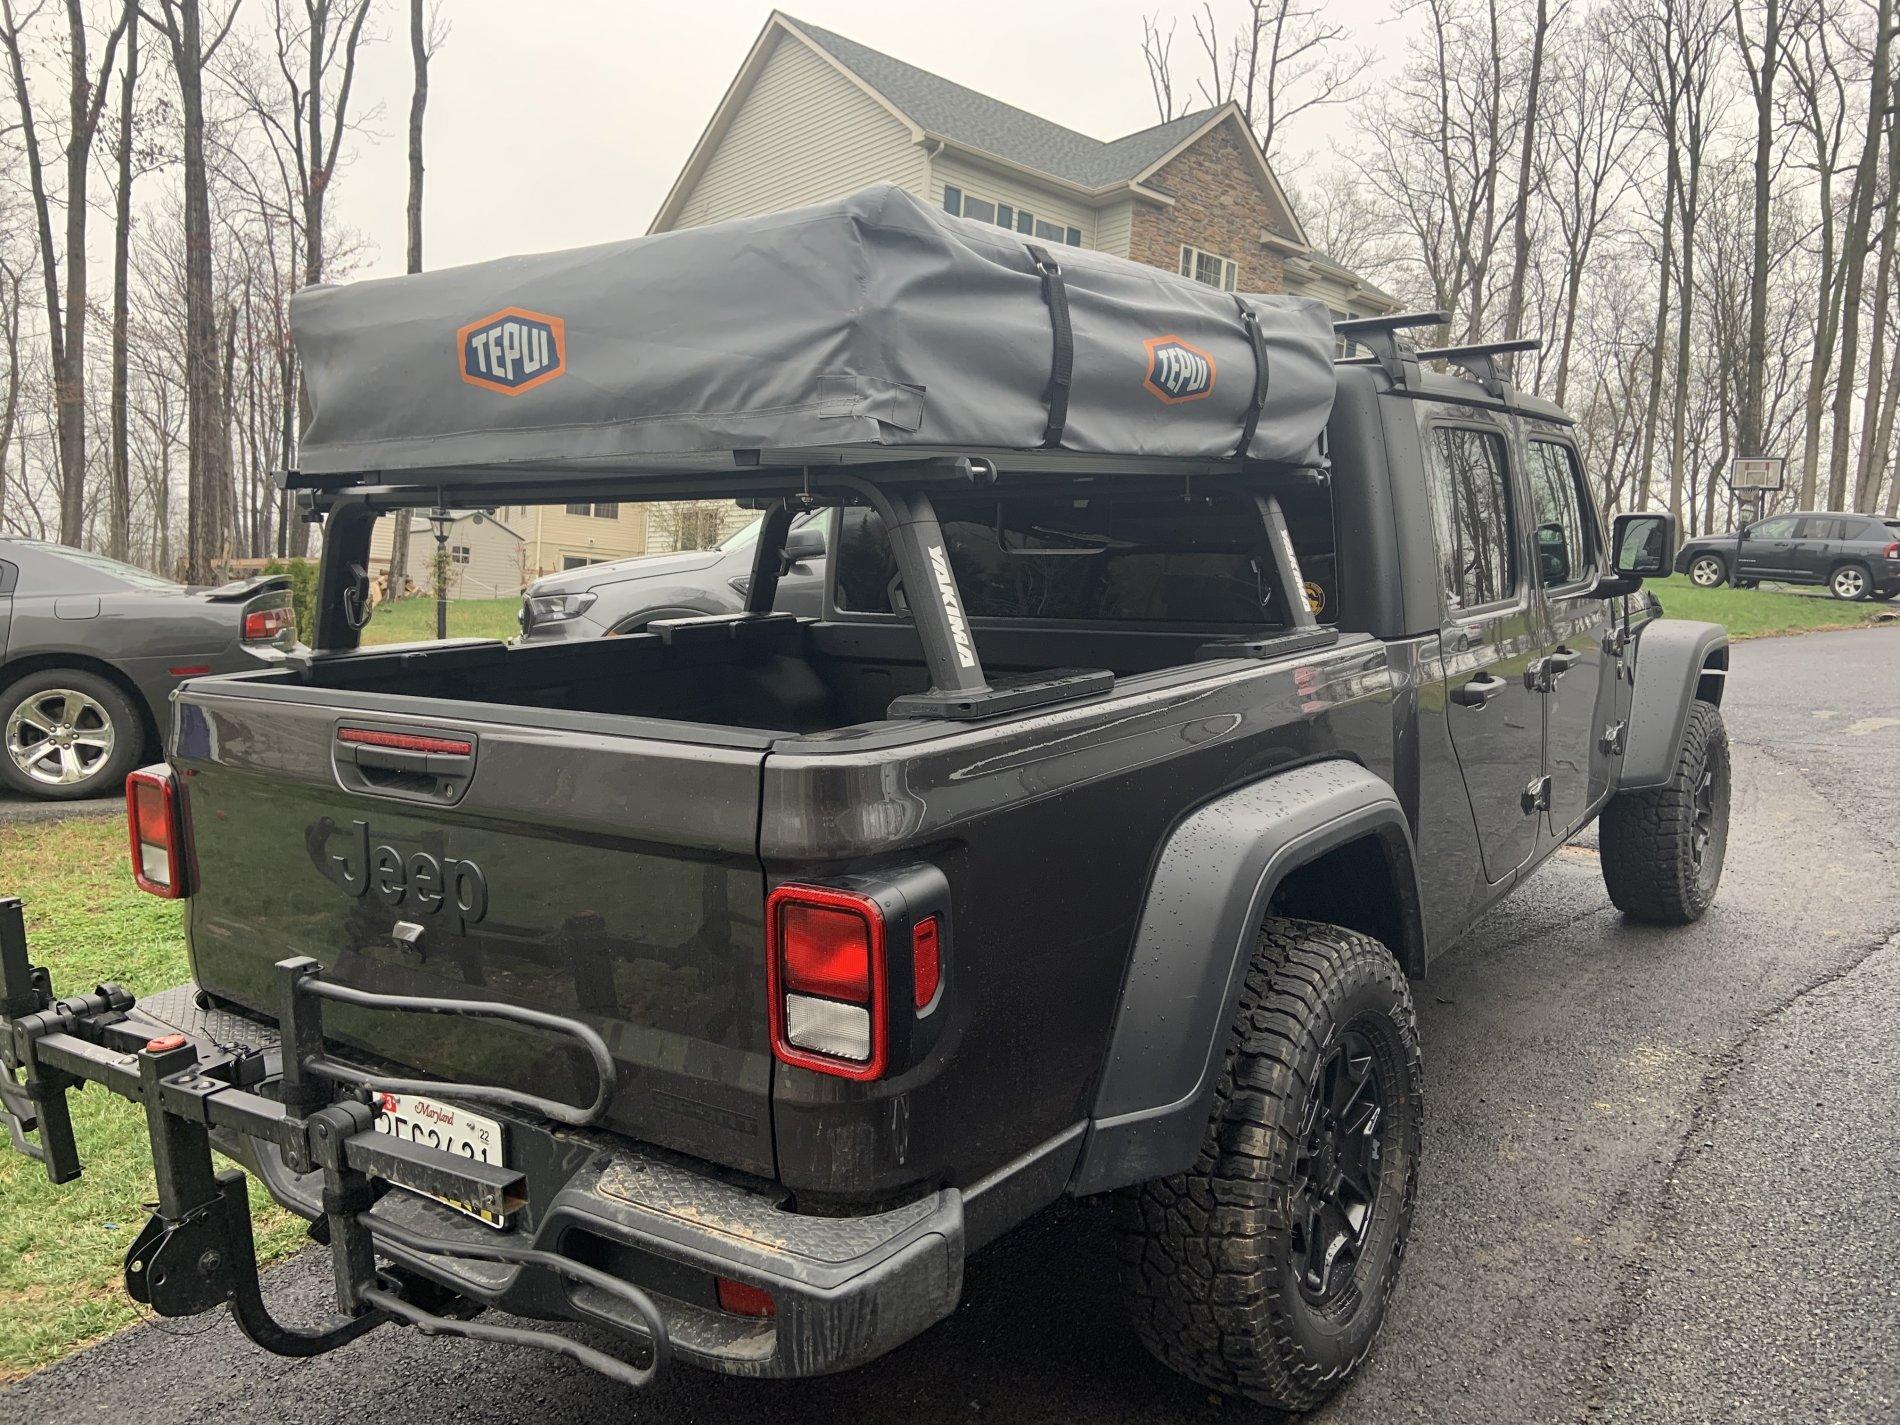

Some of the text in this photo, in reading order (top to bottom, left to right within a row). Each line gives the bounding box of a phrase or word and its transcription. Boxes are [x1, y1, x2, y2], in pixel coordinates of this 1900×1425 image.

[472, 322, 549, 380] TEPUI
[1157, 347, 1208, 393] TEPUI
[1280, 529, 1311, 612] YAKIMA
[928, 545, 975, 668] YAKIMA
[332, 820, 489, 937] Jeep
[415, 1102, 454, 1125] Maryland
[480, 1129, 490, 1143] 22
